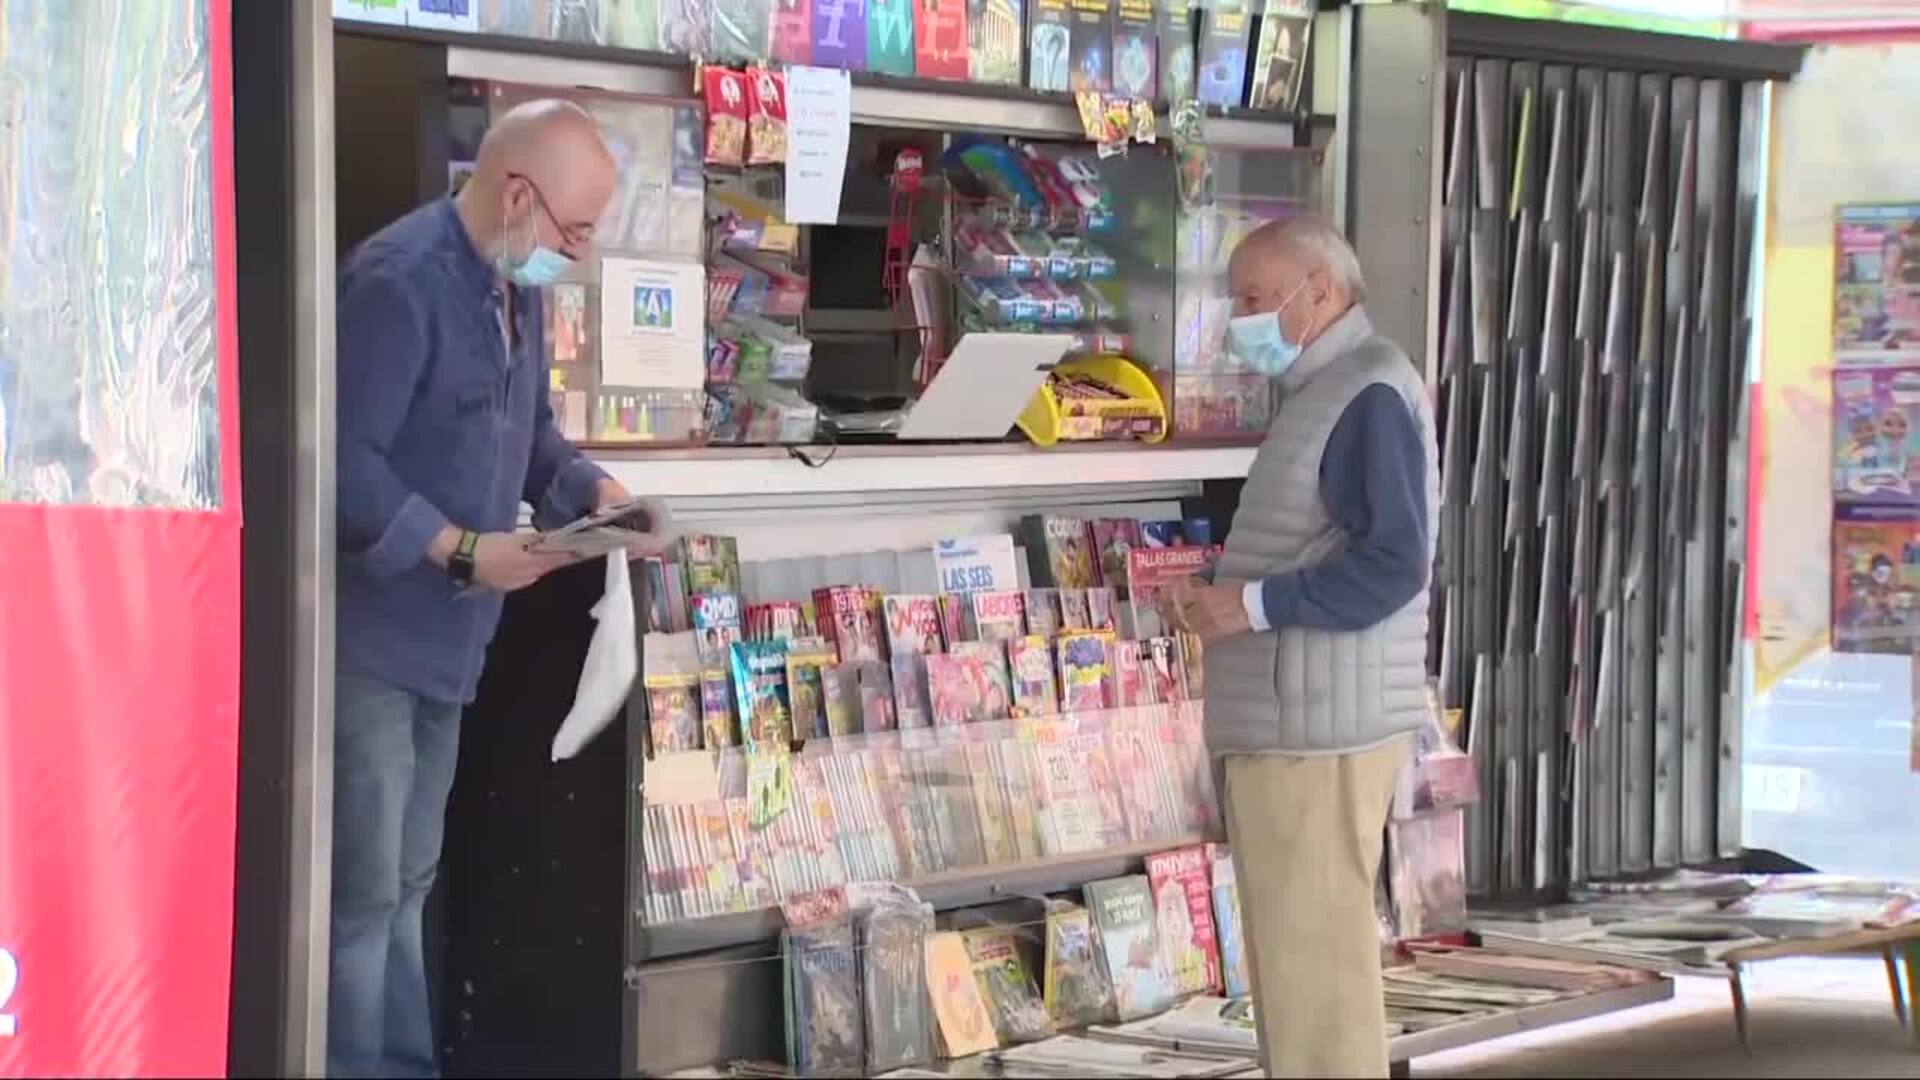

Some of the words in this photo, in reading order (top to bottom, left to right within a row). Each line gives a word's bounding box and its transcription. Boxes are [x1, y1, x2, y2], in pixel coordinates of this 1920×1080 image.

[1134, 552, 1165, 568] TALLAS
[1166, 550, 1204, 566] GRANDES
[943, 567, 967, 591] LAS
[968, 564, 993, 588] SEIS
